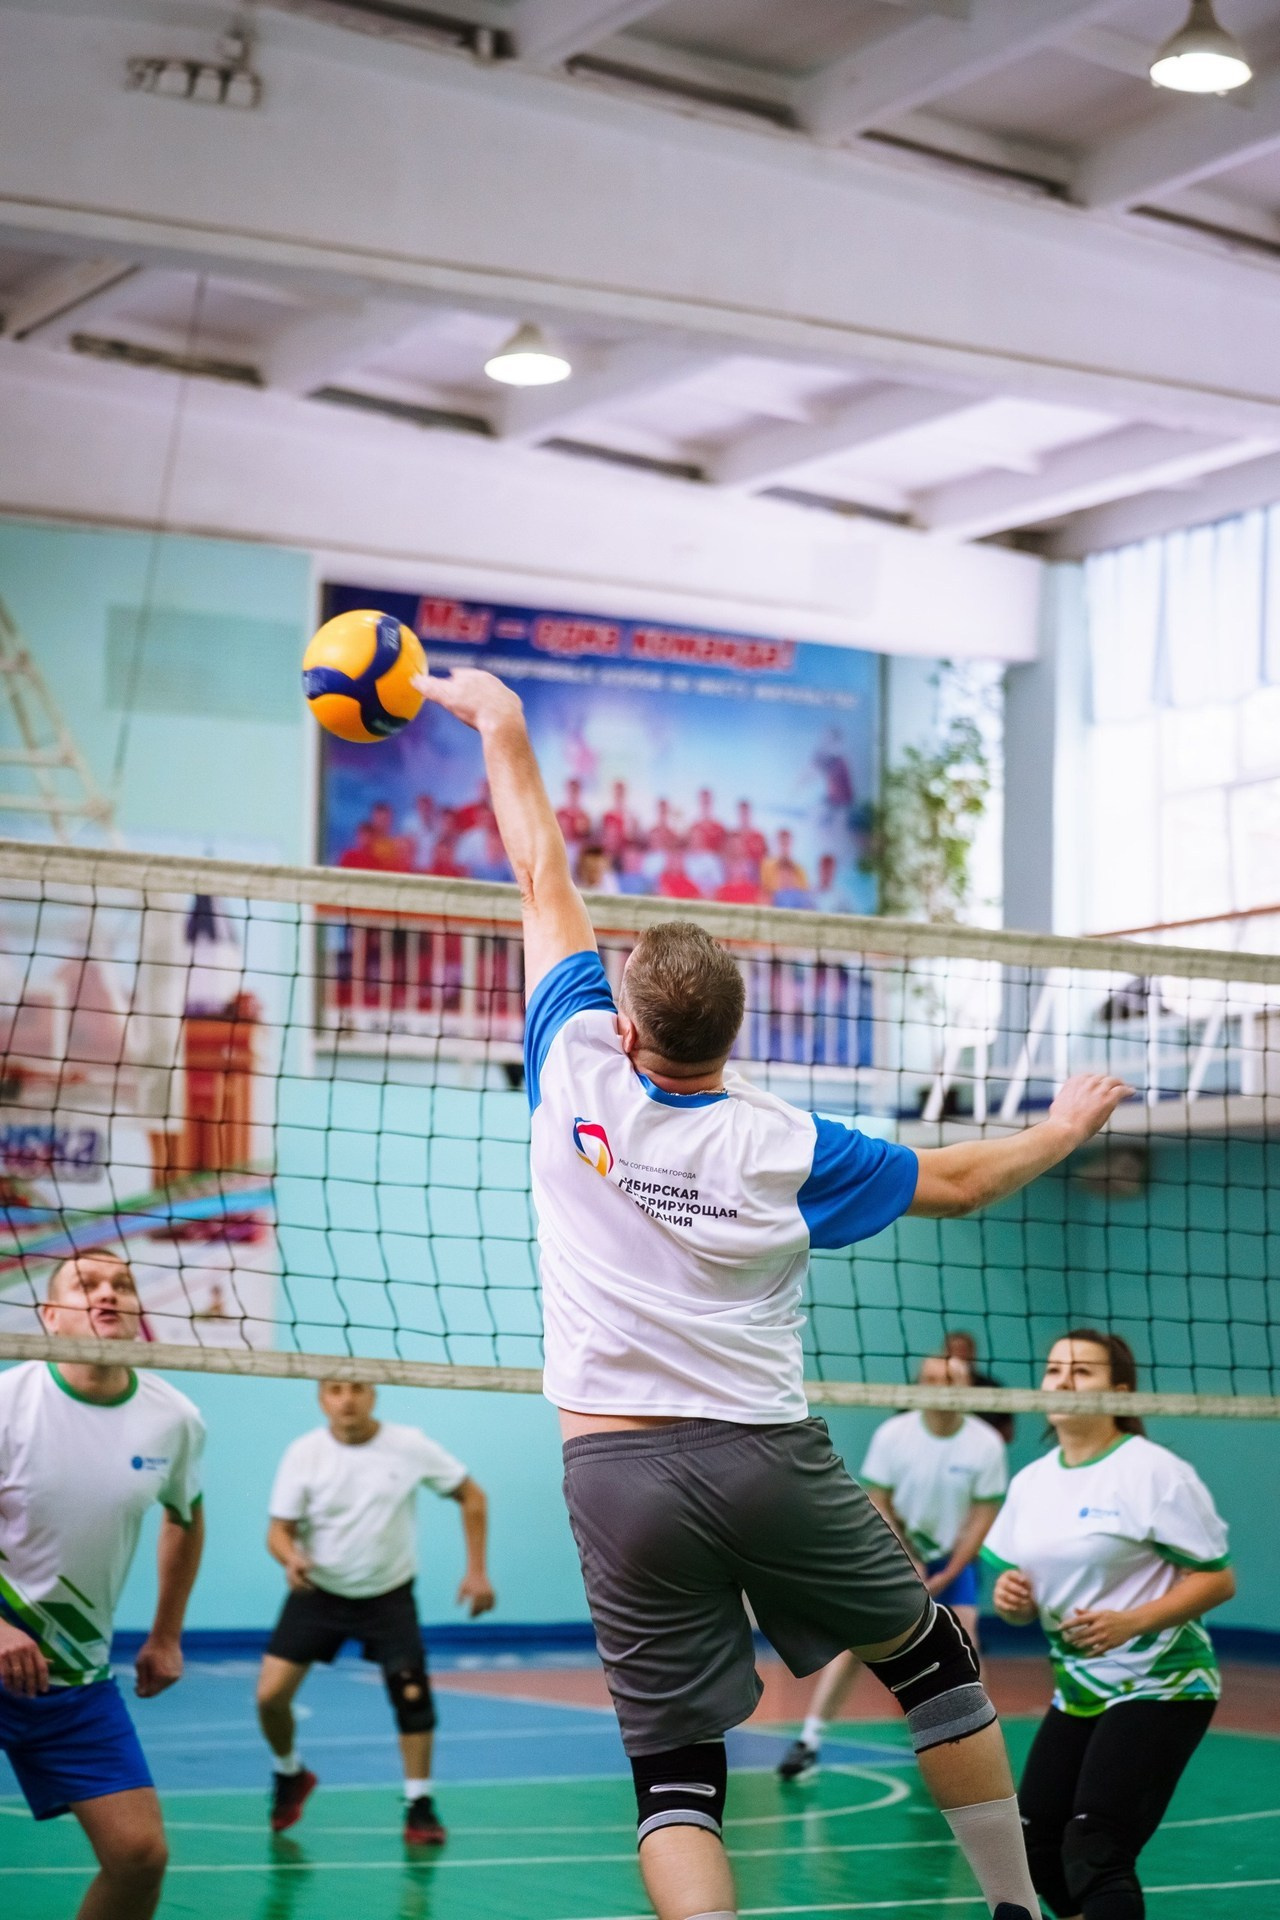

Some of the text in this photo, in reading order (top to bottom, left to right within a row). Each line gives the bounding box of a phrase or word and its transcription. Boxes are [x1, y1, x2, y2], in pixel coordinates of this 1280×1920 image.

[618, 1158, 696, 1180] МЫ СОГРЕВАЕМ ГОРОДА
[624, 1177, 698, 1201] ИБИРСКАЯ
